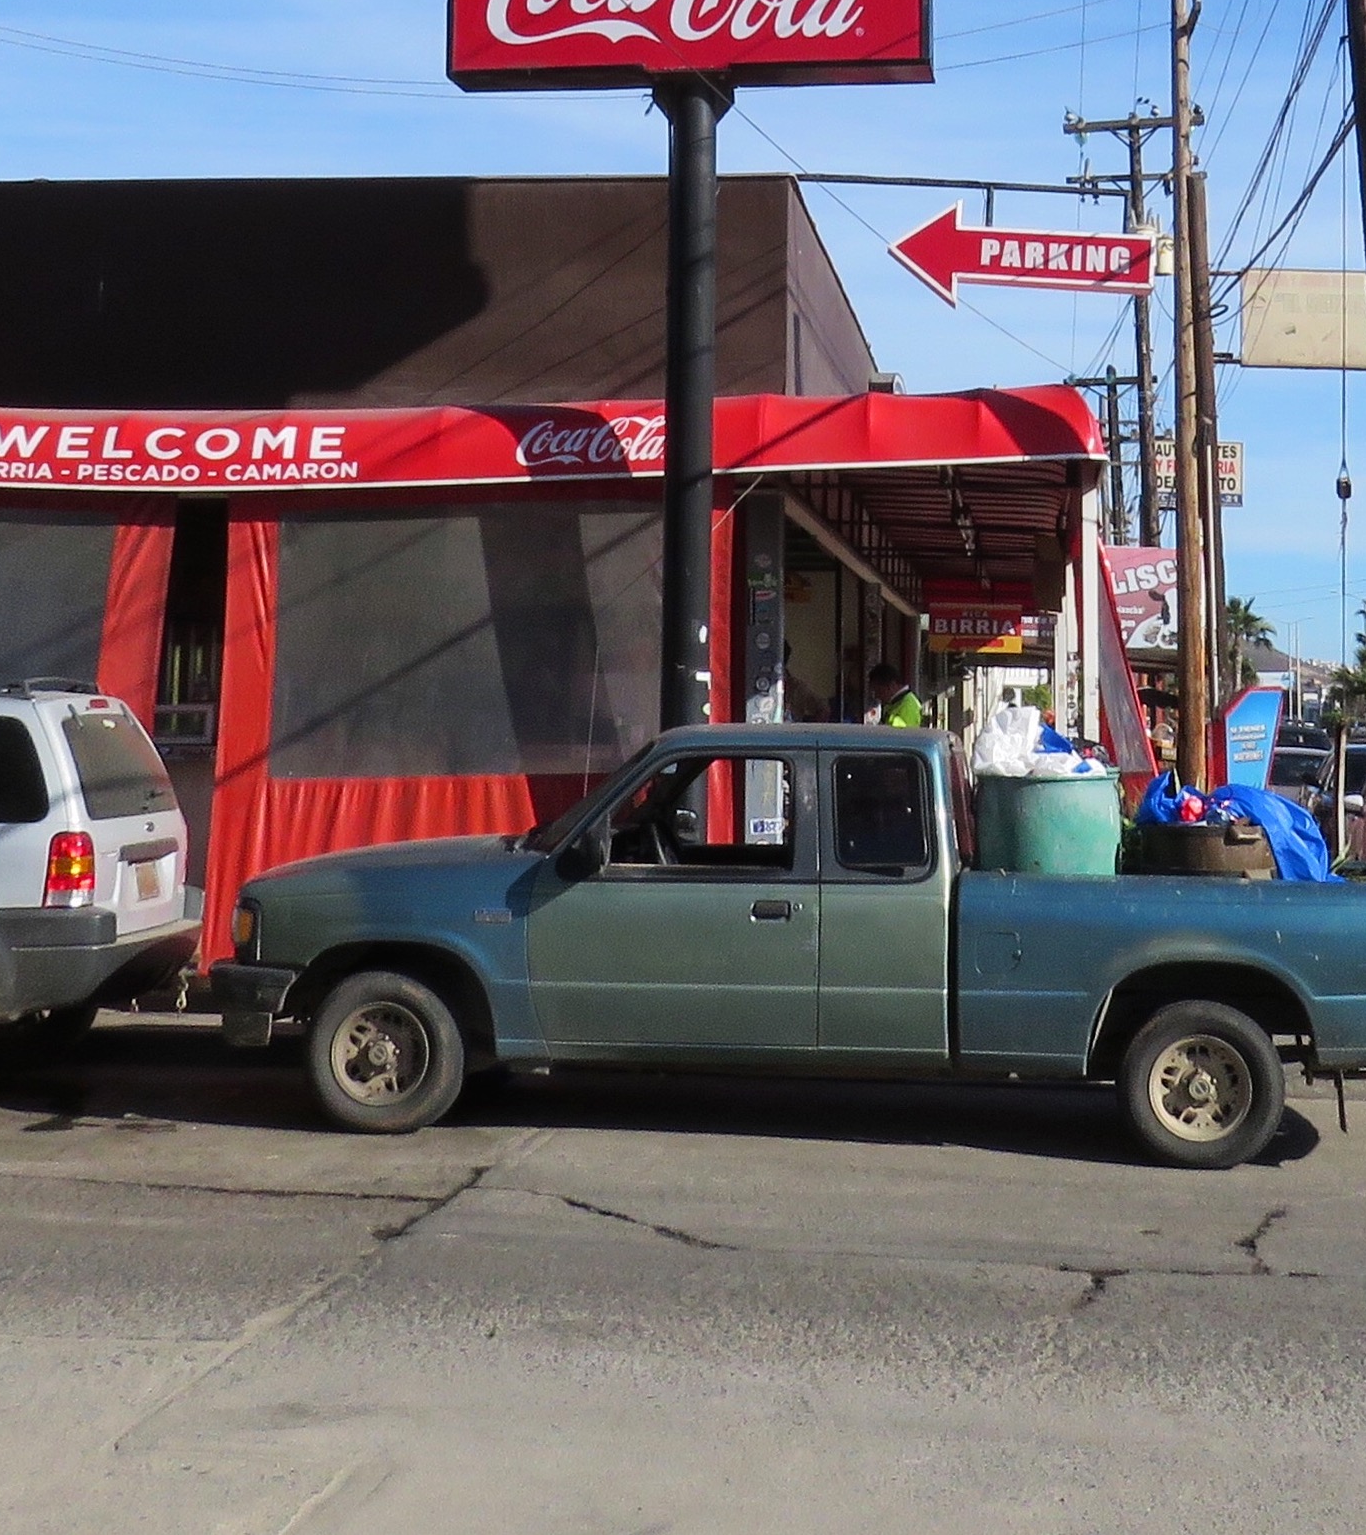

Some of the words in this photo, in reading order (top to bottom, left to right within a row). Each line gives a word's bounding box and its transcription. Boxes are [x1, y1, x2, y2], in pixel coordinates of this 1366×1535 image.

[980, 238, 1131, 275] PARKING
[515, 414, 666, 467] Coca-Cola
[77, 464, 201, 482] PESCADO
[225, 462, 358, 482] CAMARON
[1110, 558, 1177, 595] LISC
[934, 618, 1016, 635] BIRRIA
